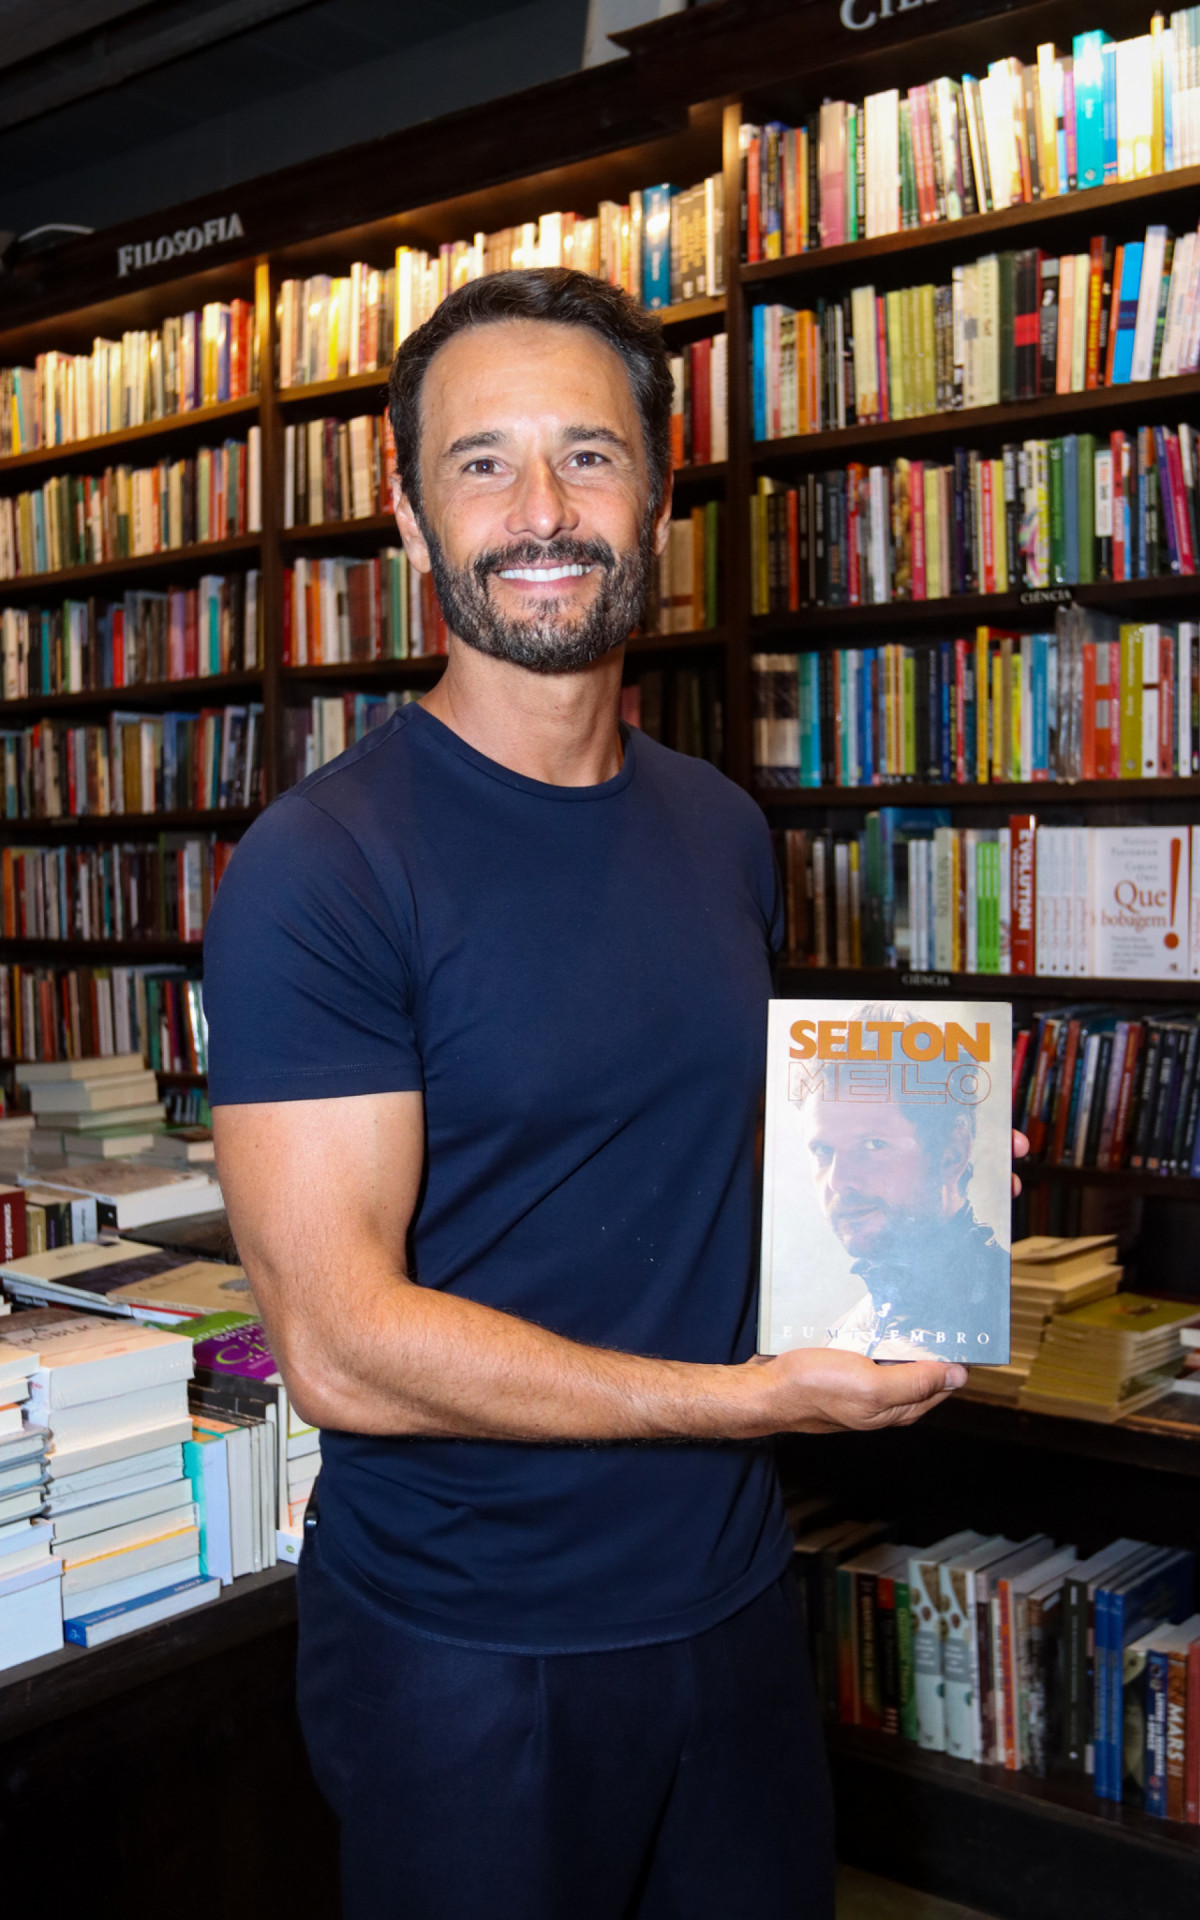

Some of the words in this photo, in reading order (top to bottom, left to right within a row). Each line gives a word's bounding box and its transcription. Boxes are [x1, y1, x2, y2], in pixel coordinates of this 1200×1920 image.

[117, 212, 244, 278] FILOSOFIA
[1019, 829, 1032, 930] EVOLUTION
[1114, 880, 1167, 914] Que
[788, 1020, 991, 1063] SELTON
[788, 1061, 992, 1106] MELLO
[783, 1325, 815, 1340] EU
[871, 1328, 991, 1345] LEMBRO
[1167, 1703, 1185, 1763] MARS
